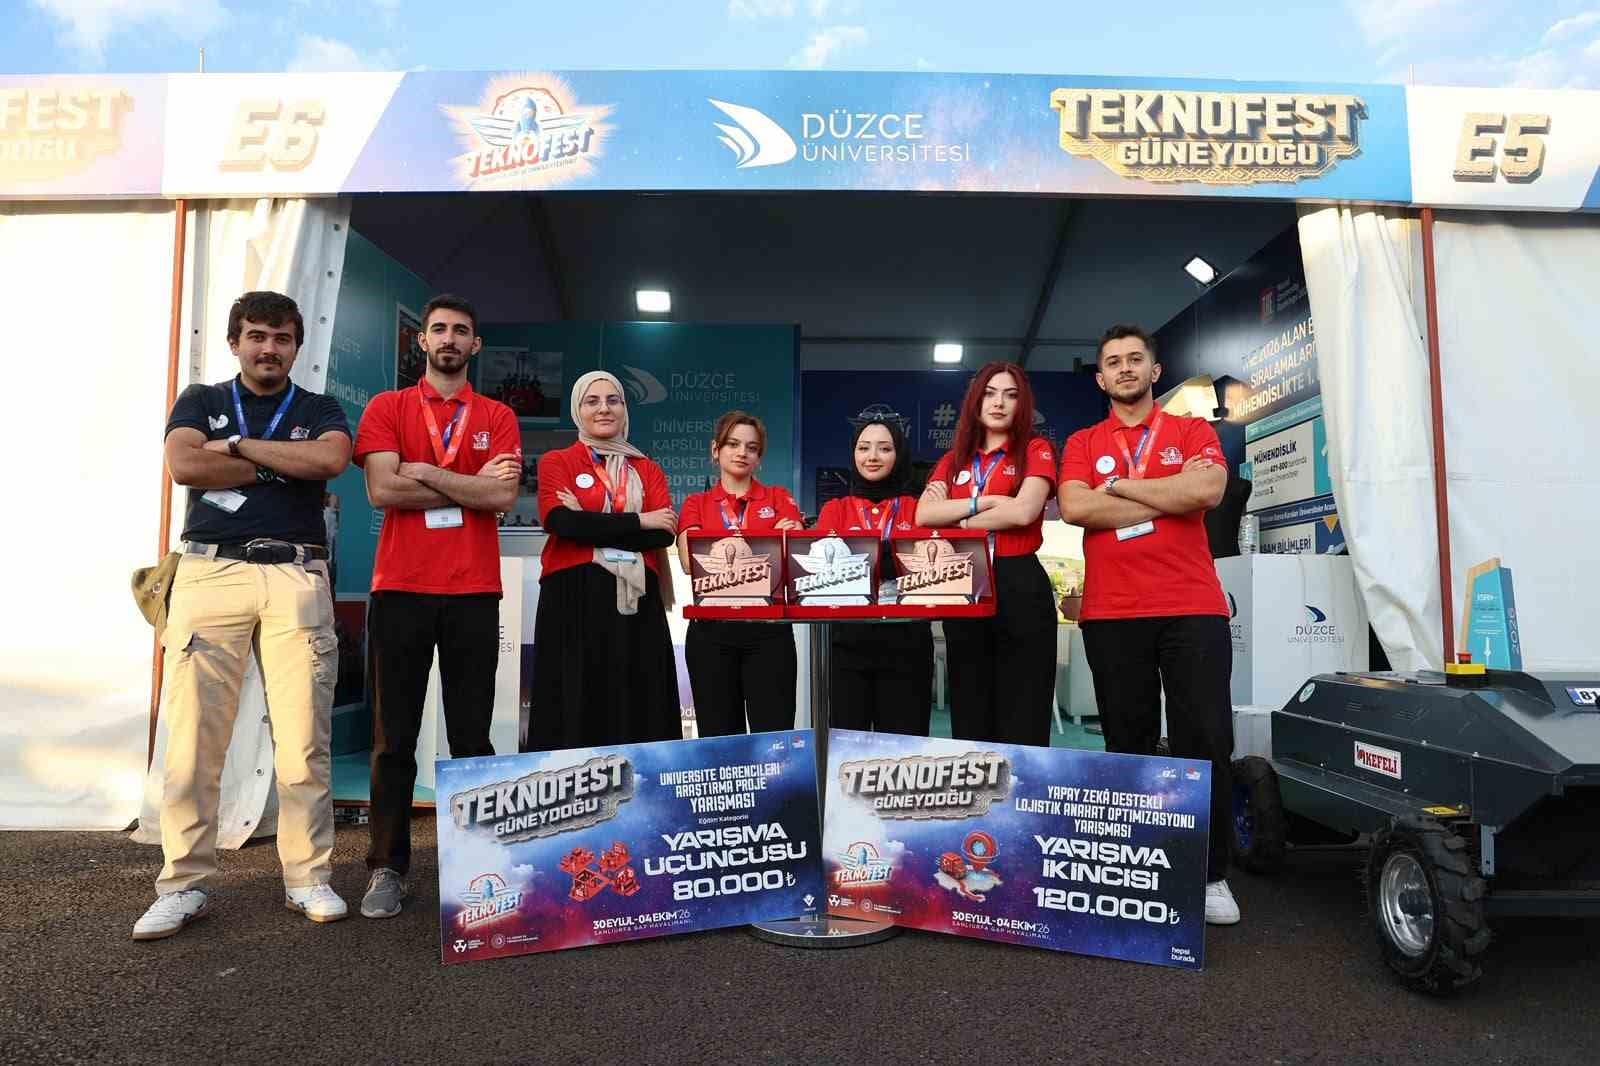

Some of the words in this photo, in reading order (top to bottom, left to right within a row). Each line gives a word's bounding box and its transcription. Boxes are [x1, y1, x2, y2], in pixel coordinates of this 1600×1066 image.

[802, 108, 925, 139] DÜZCE
[1052, 88, 1366, 140] TEKNOFEST
[220, 99, 328, 171] E6
[1453, 112, 1552, 184] E5
[468, 127, 595, 178] TEKNOFEST
[803, 143, 970, 162] ÜNİVERSİTESİ
[1118, 138, 1323, 167] GÜNEYDOĞU
[671, 370, 737, 388] DÜZCE
[693, 561, 772, 593] TEKNOFEST
[794, 561, 870, 592] TEKNOFEST
[896, 560, 974, 593] TEKNOFEST
[1295, 624, 1335, 635] DÜZCE
[735, 776, 767, 791] PROJE
[843, 758, 1005, 795] TEKNOFEST
[454, 757, 627, 827] TEKNOFEST
[690, 791, 755, 814] YARIŞMASI
[873, 788, 973, 810] GÜNEYDOĞU
[1047, 785, 1080, 800] YAPAY
[494, 797, 598, 836] GÜNEYDOĞU
[1063, 803, 1105, 820] ANAHAT
[661, 822, 788, 852] YARIŞMA
[1074, 820, 1132, 838] YARIŞMASI
[1034, 835, 1171, 869] YARIŞMA
[834, 865, 892, 881] TEKNOFEST
[456, 893, 522, 928] TEKNOFEST
[1171, 946, 1190, 956] hepsi
[1171, 954, 1195, 963] burada
